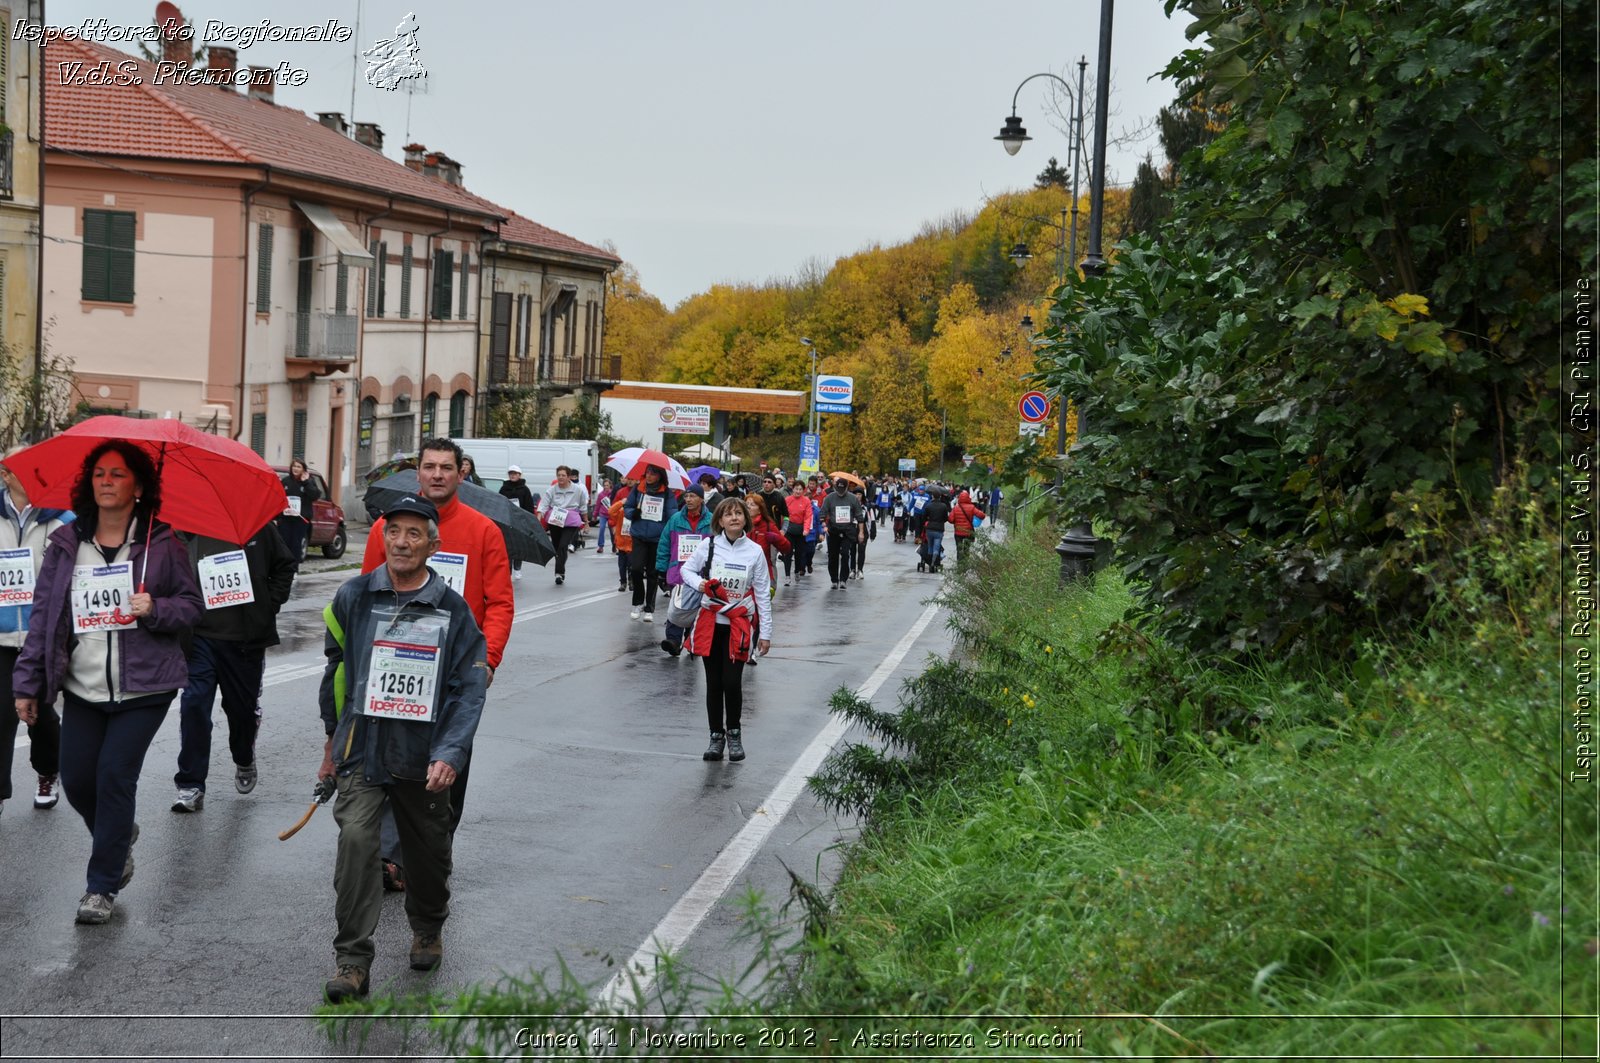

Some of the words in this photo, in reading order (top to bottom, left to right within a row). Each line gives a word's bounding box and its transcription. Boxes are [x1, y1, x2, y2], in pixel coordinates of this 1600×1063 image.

[647, 505, 657, 513] 378
[210, 572, 241, 590] 7055
[83, 589, 120, 609] 1490
[208, 591, 249, 606] ipercoop
[380, 672, 424, 696] 12561
[370, 696, 427, 716] ipercoop
